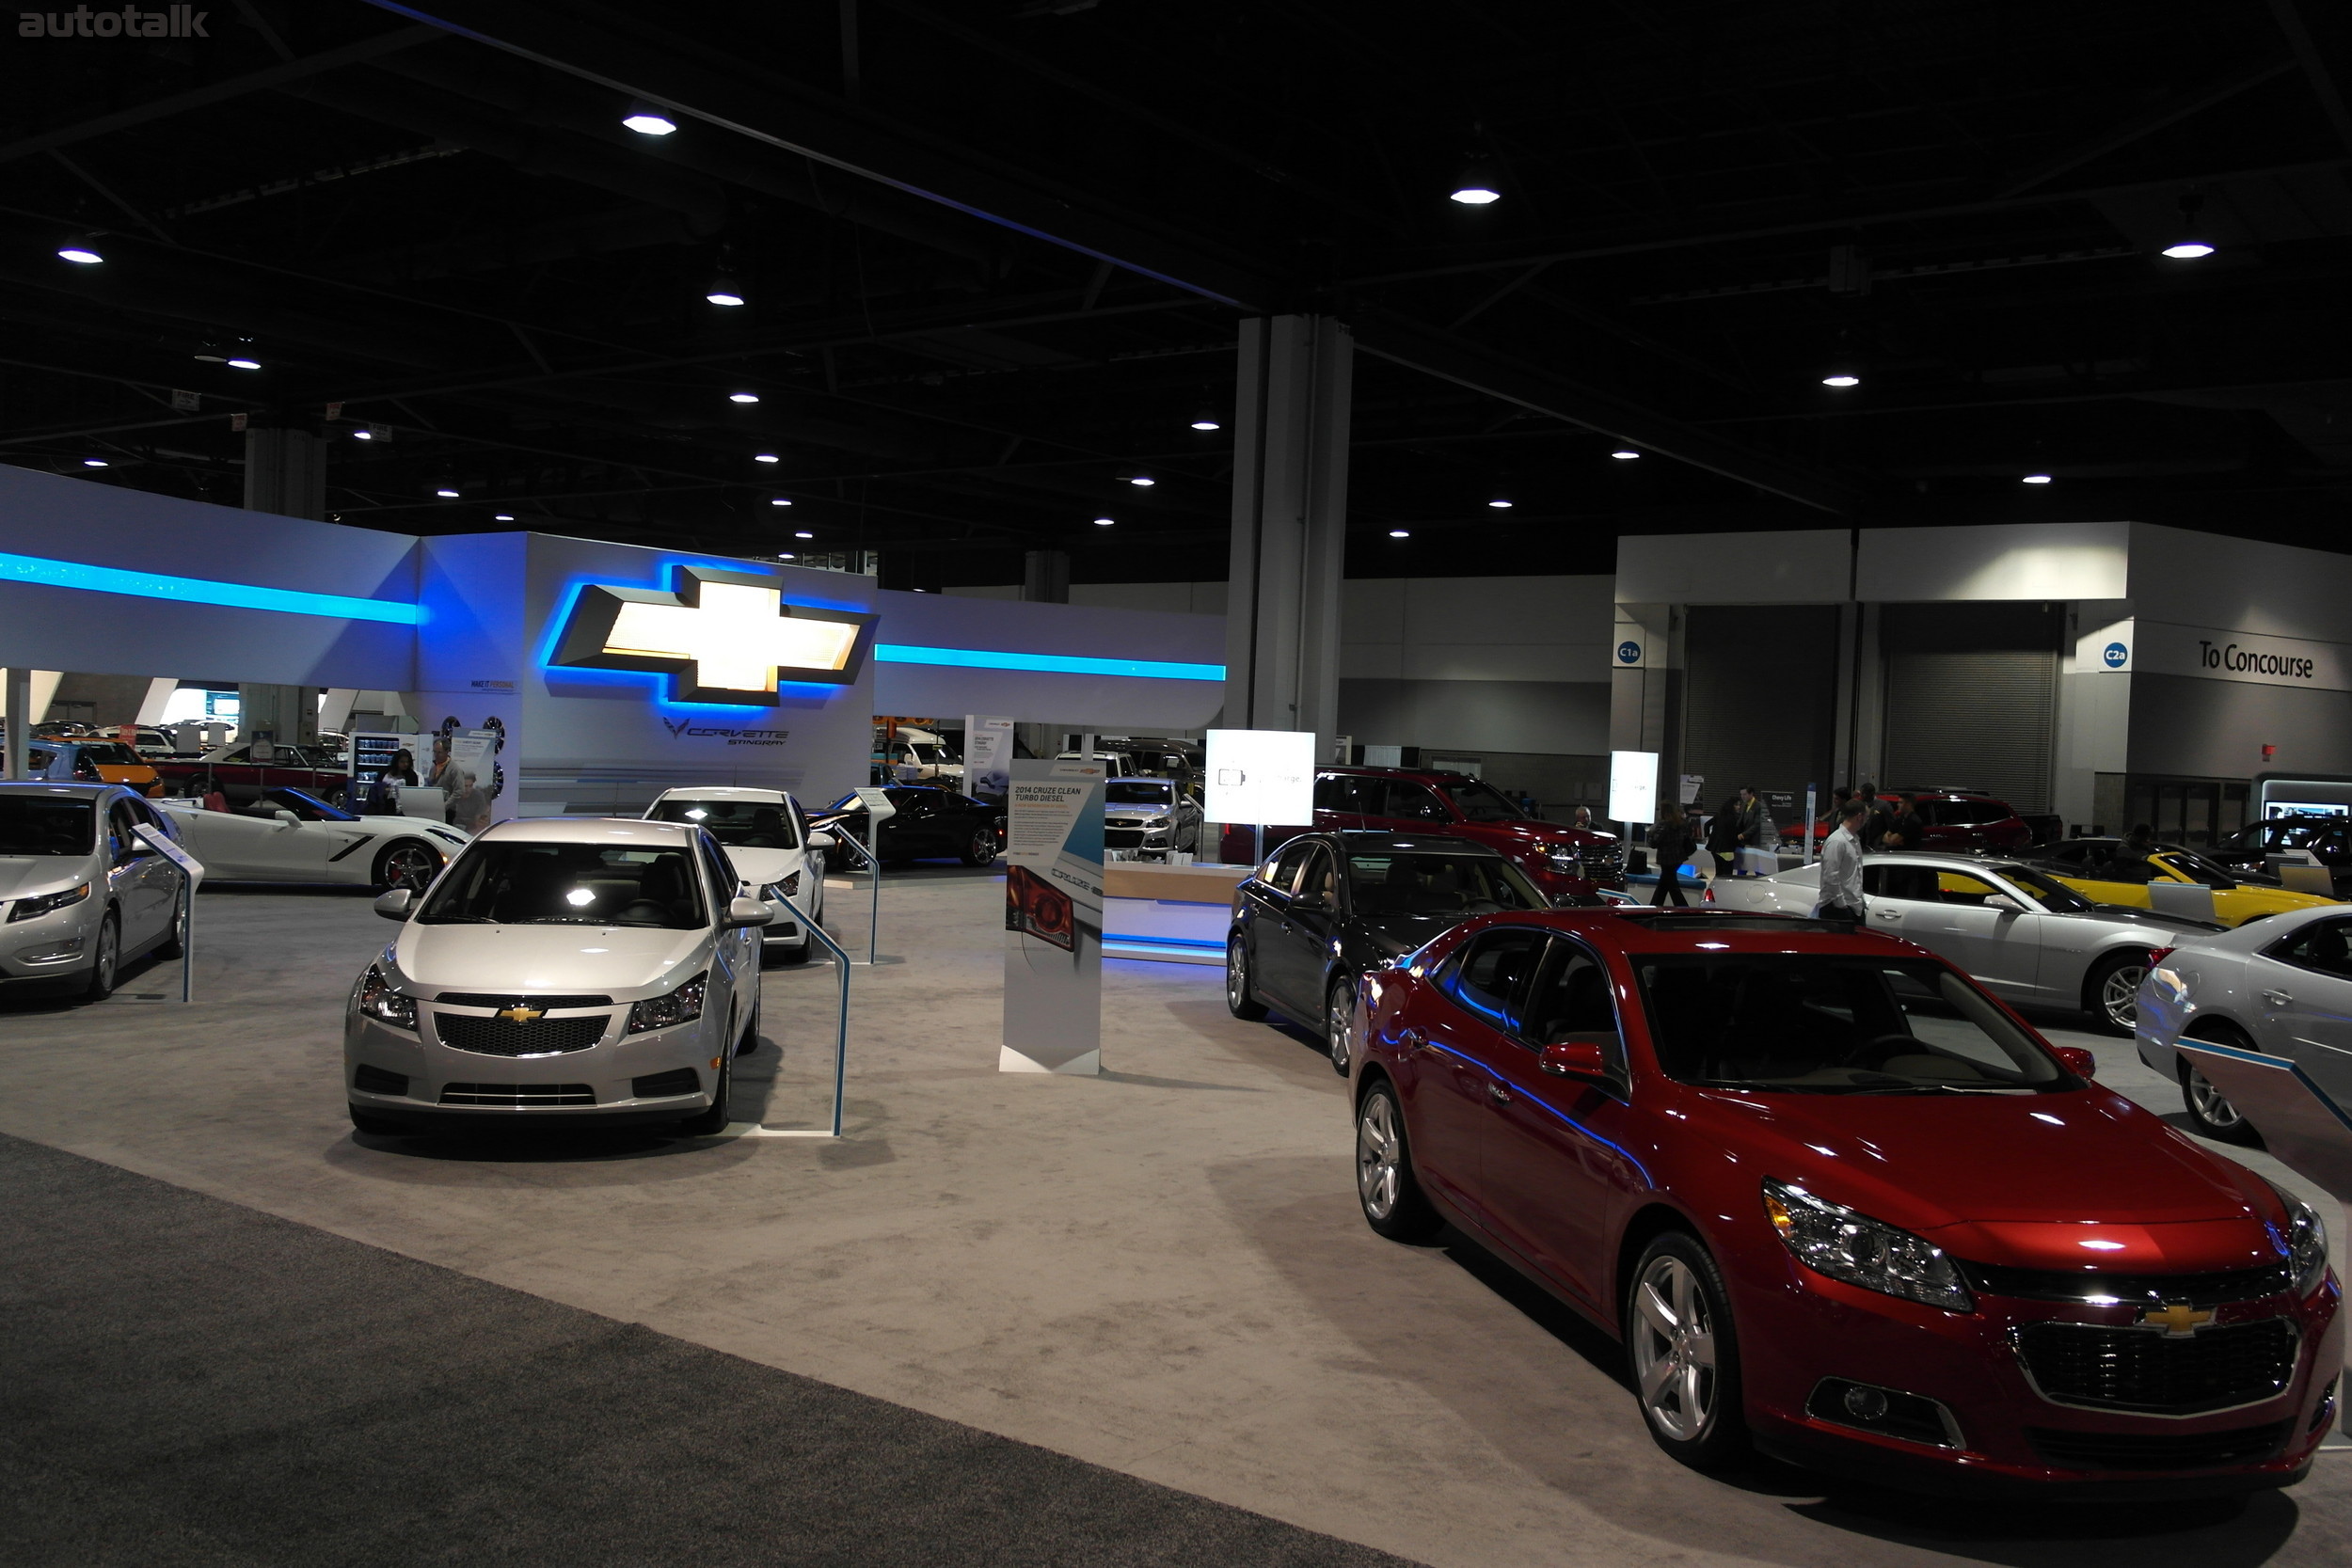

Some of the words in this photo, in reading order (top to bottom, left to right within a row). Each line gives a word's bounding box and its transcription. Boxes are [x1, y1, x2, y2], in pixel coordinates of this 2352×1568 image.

[1619, 647, 1638, 657] C1a
[2106, 650, 2126, 660] C2a
[2199, 641, 2221, 669] To
[2224, 643, 2313, 679] Concourse
[687, 727, 790, 739] CORVETTE
[727, 738, 787, 747] STINGRAY
[1033, 786, 1057, 795] CRUZE
[1057, 787, 1081, 796] CLEAN
